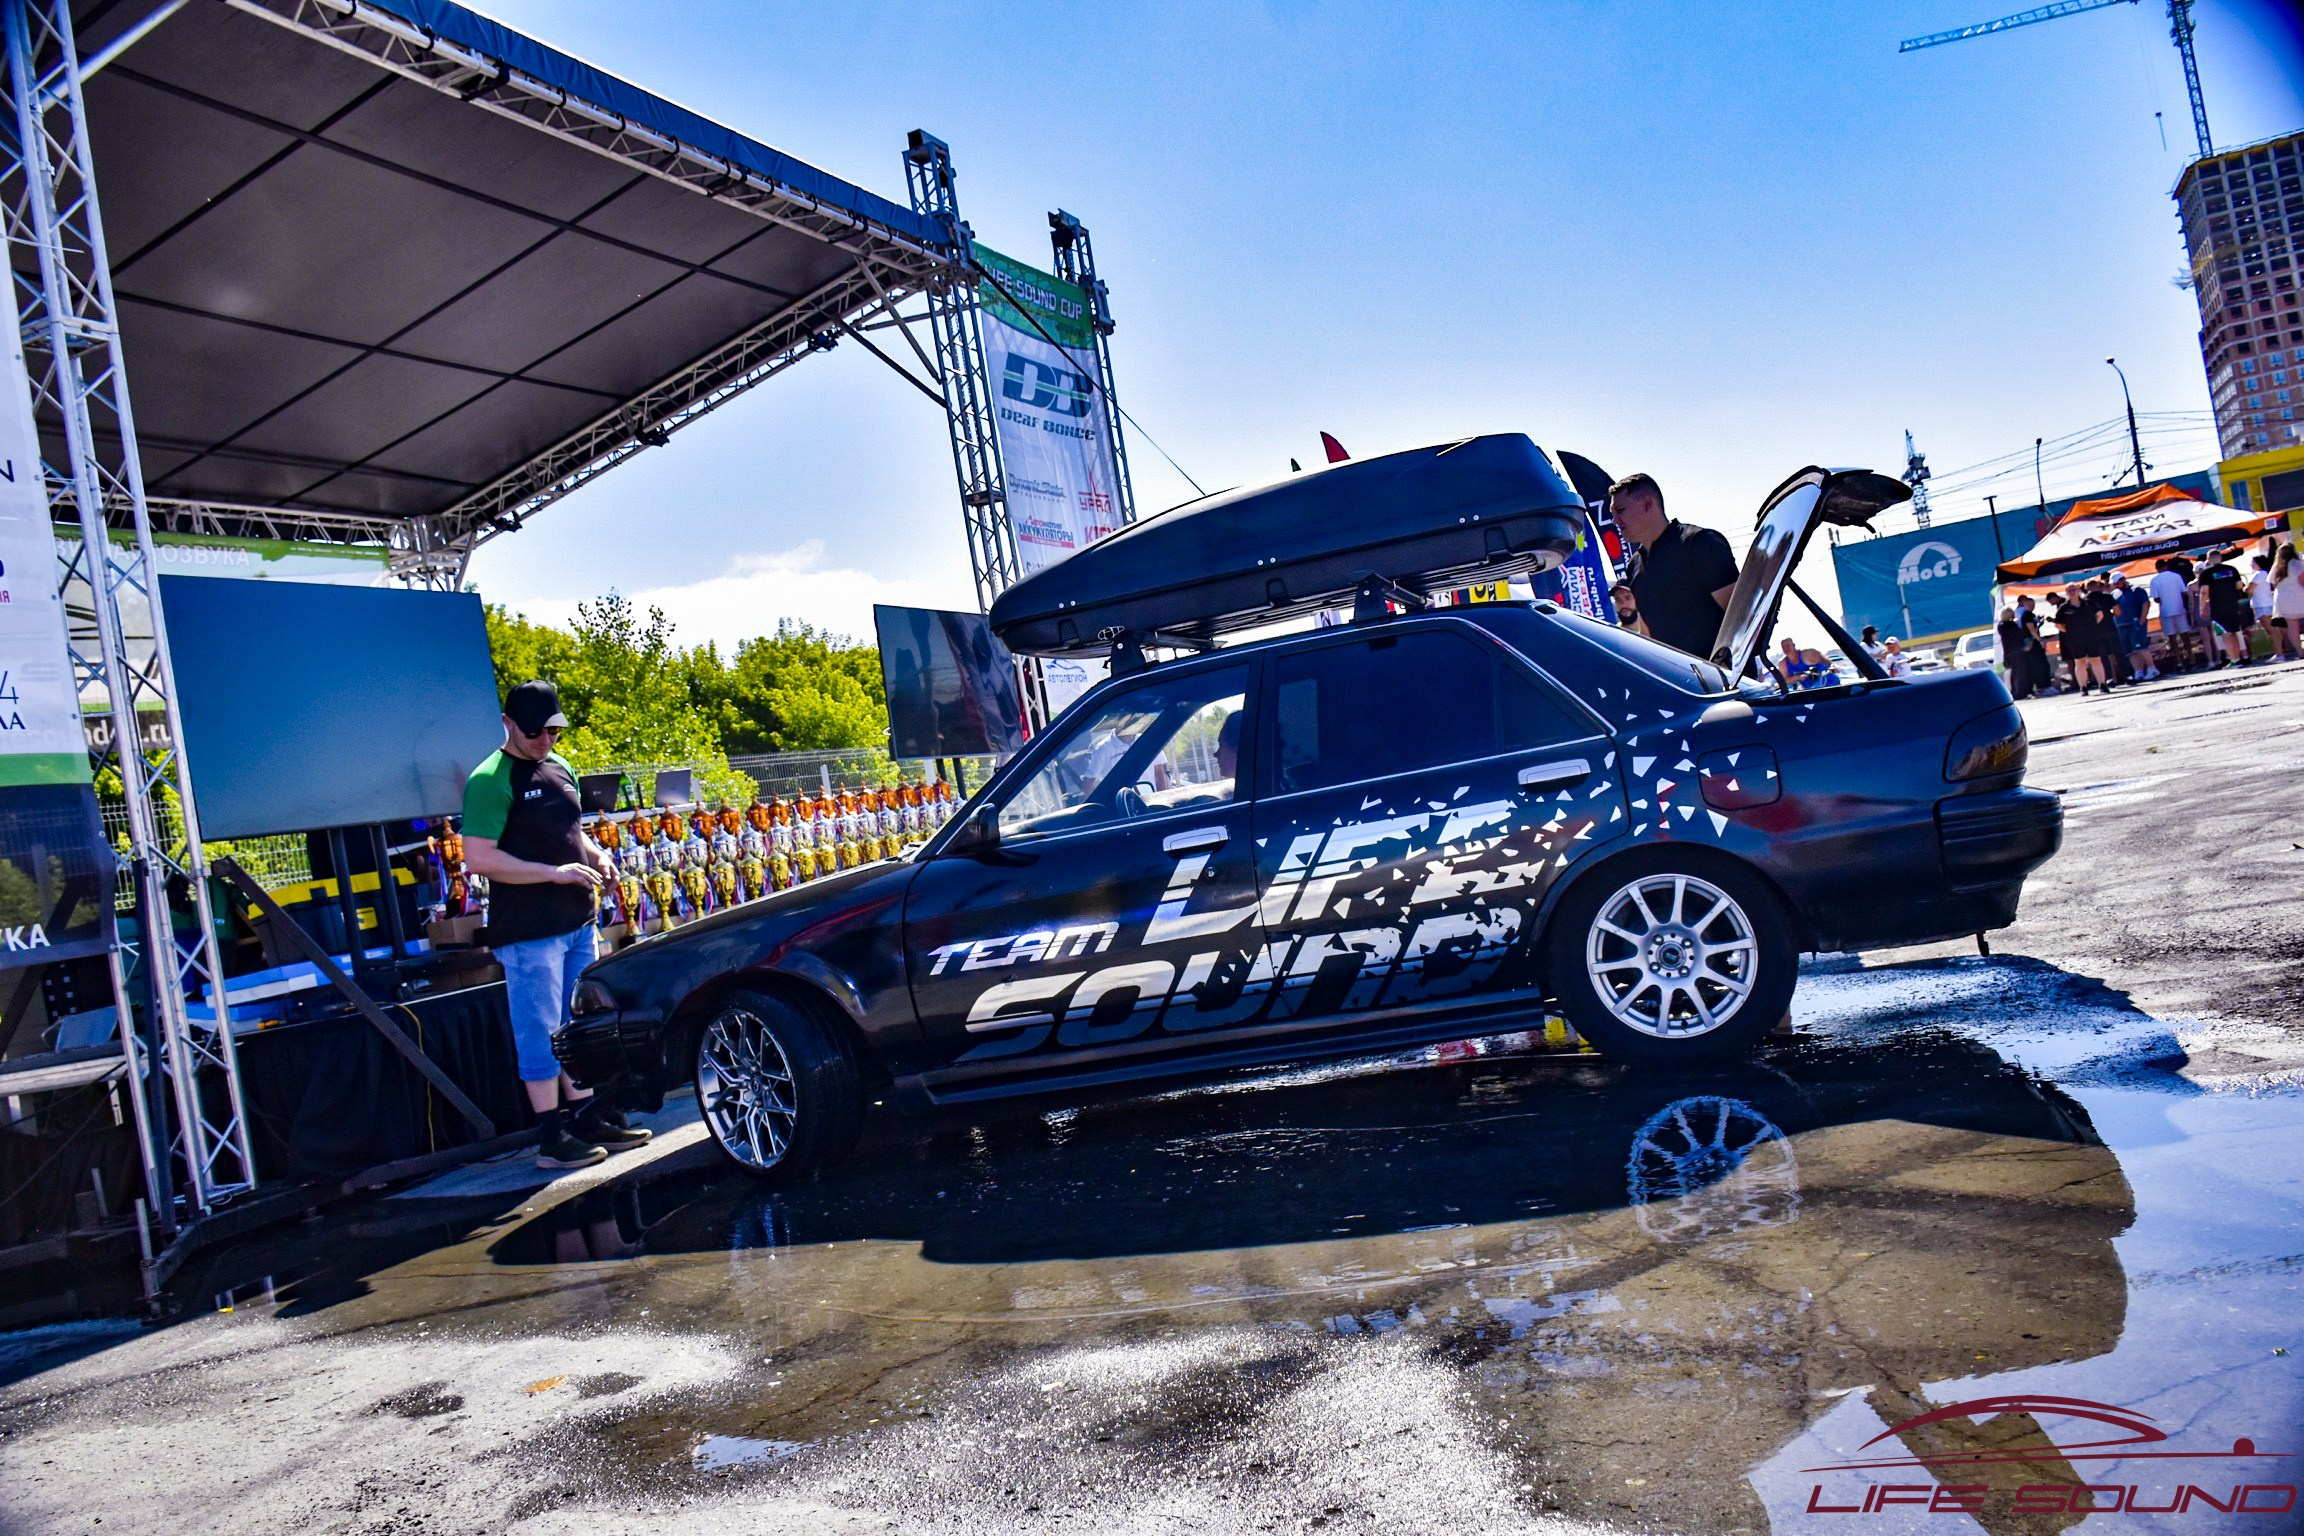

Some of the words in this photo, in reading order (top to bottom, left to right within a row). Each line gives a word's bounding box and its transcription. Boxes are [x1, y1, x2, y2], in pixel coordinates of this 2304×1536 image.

[1016, 279, 1057, 311] SOUND
[1060, 297, 1083, 320] CUP
[2096, 513, 2165, 531] TEAM
[2100, 539, 2180, 560] http://avatar.audio
[1141, 798, 1543, 946] LIFE
[927, 921, 1119, 976] TEAM
